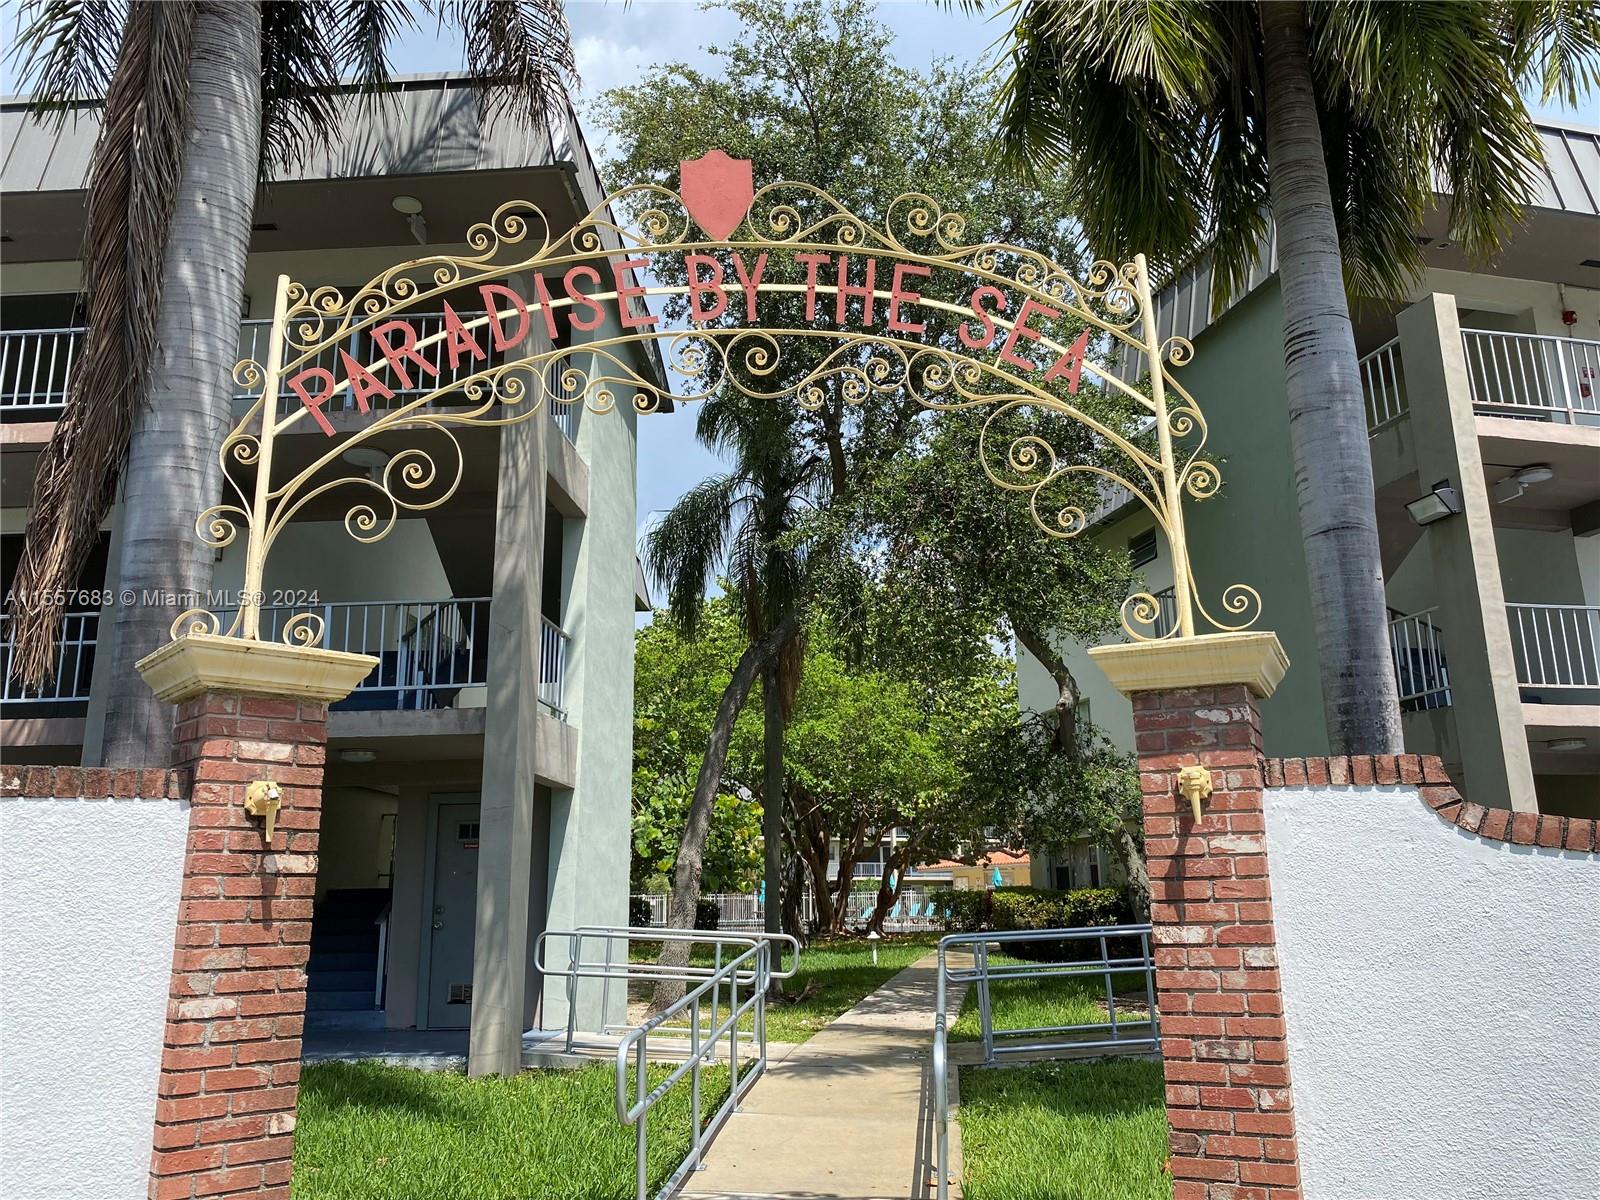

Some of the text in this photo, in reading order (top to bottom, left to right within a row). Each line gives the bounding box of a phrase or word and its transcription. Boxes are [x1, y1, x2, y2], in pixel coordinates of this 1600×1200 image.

[287, 253, 1092, 437] PARADISE BY THE SEA
